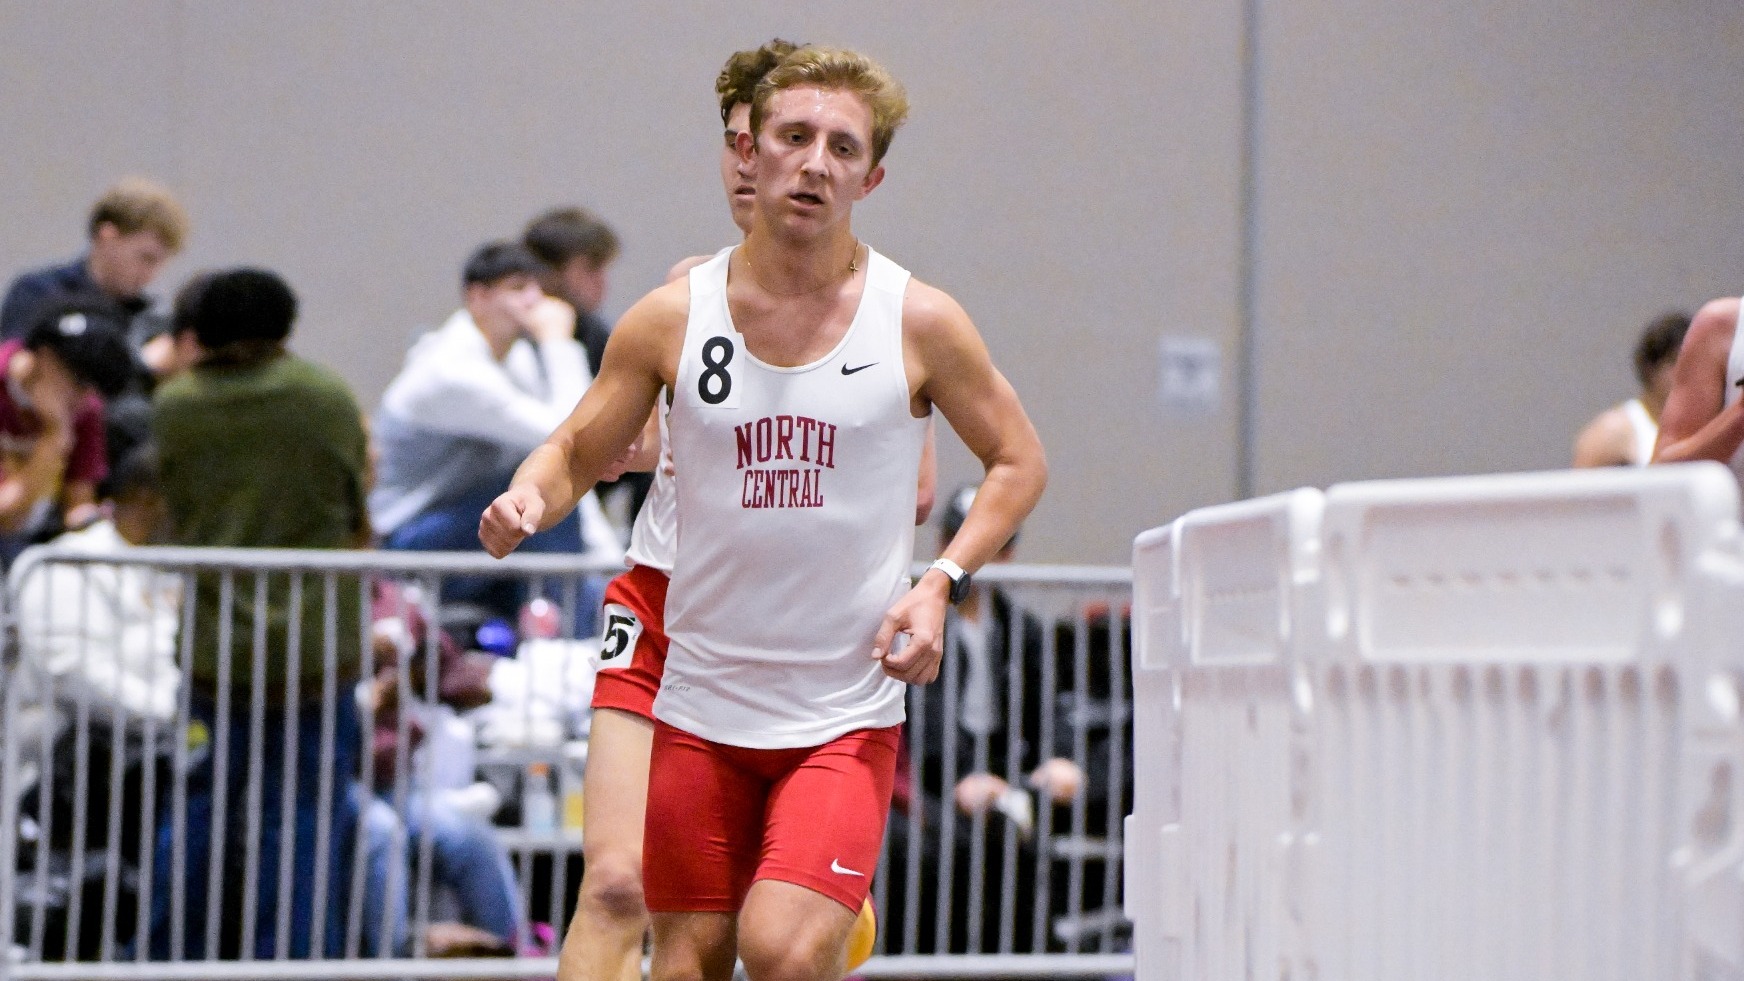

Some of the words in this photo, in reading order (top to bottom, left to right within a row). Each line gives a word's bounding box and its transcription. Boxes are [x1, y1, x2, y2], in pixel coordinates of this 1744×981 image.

[698, 335, 735, 405] 8
[734, 414, 837, 470] NORTH
[741, 468, 824, 509] CENTRAL
[600, 614, 636, 661] 5
